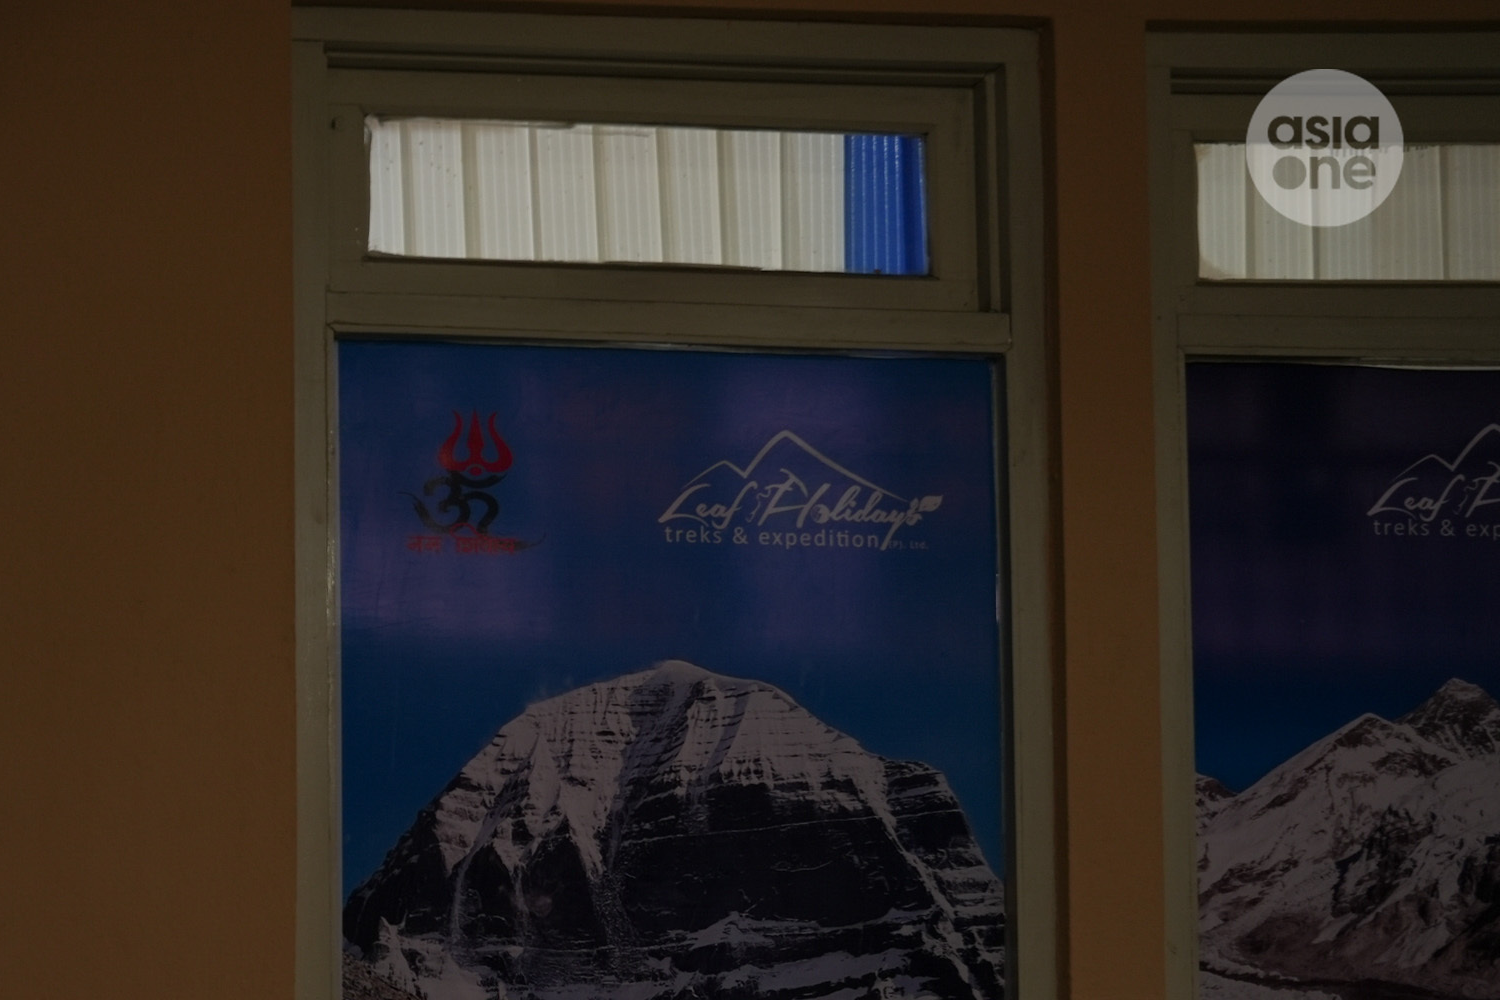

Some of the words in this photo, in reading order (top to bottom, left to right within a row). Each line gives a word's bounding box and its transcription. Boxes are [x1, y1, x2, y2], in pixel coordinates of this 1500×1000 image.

[657, 481, 758, 530] Leaf
[757, 467, 924, 551] Holidays
[1366, 473, 1466, 522] Leaf
[664, 525, 723, 545] treks
[732, 525, 750, 546] &
[757, 527, 880, 550] expedition
[1373, 518, 1430, 536] treks
[1440, 518, 1456, 537] &
